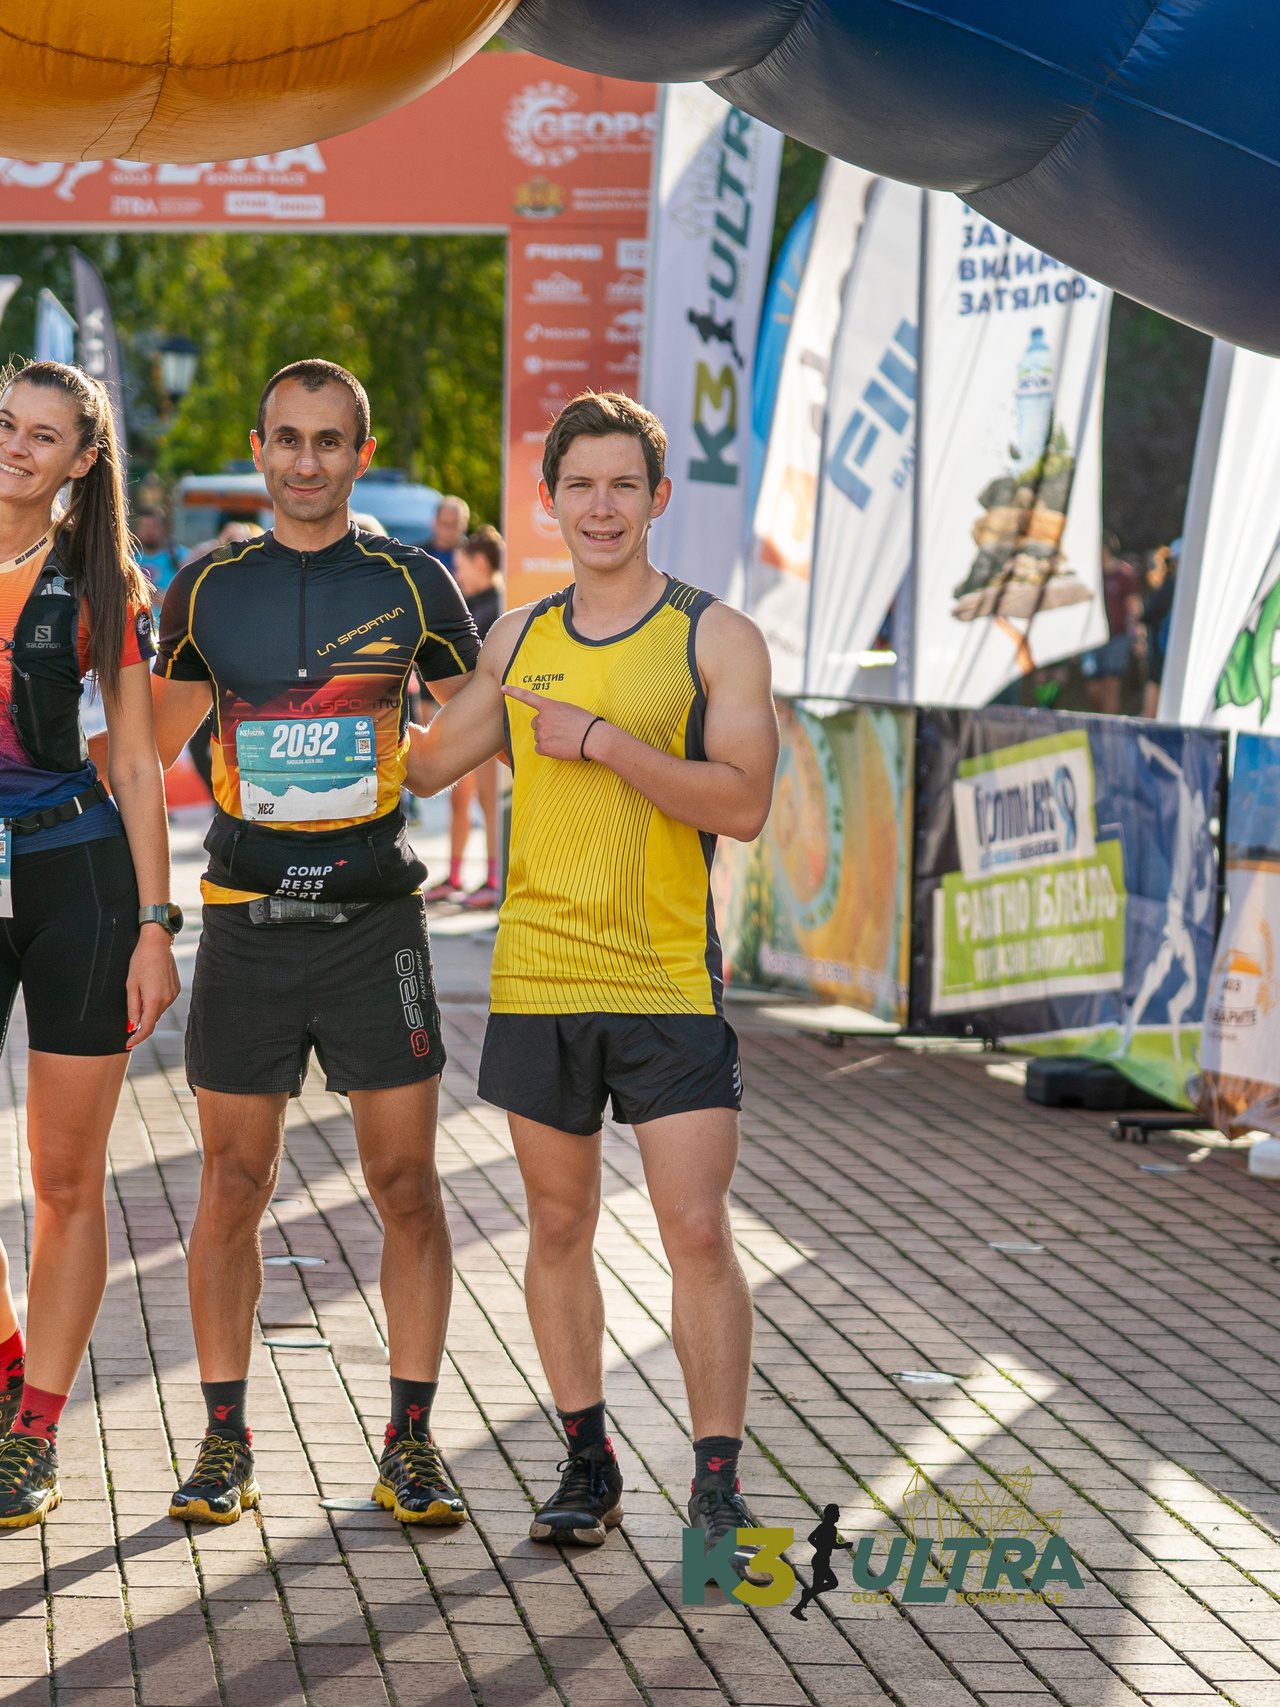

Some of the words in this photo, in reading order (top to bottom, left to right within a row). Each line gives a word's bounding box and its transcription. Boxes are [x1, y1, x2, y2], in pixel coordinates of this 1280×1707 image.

[708, 104, 752, 300] ULTR
[688, 360, 739, 486] K3
[316, 642, 337, 657] LA
[337, 606, 405, 646] SPORTIVA
[522, 674, 533, 684] СК
[534, 673, 565, 682] АКТИВ
[531, 682, 551, 691] 2013
[289, 701, 314, 713] LA
[270, 721, 340, 759] 2032
[286, 865, 333, 877] COMP
[280, 878, 324, 891] RESS
[274, 889, 321, 900] PORT
